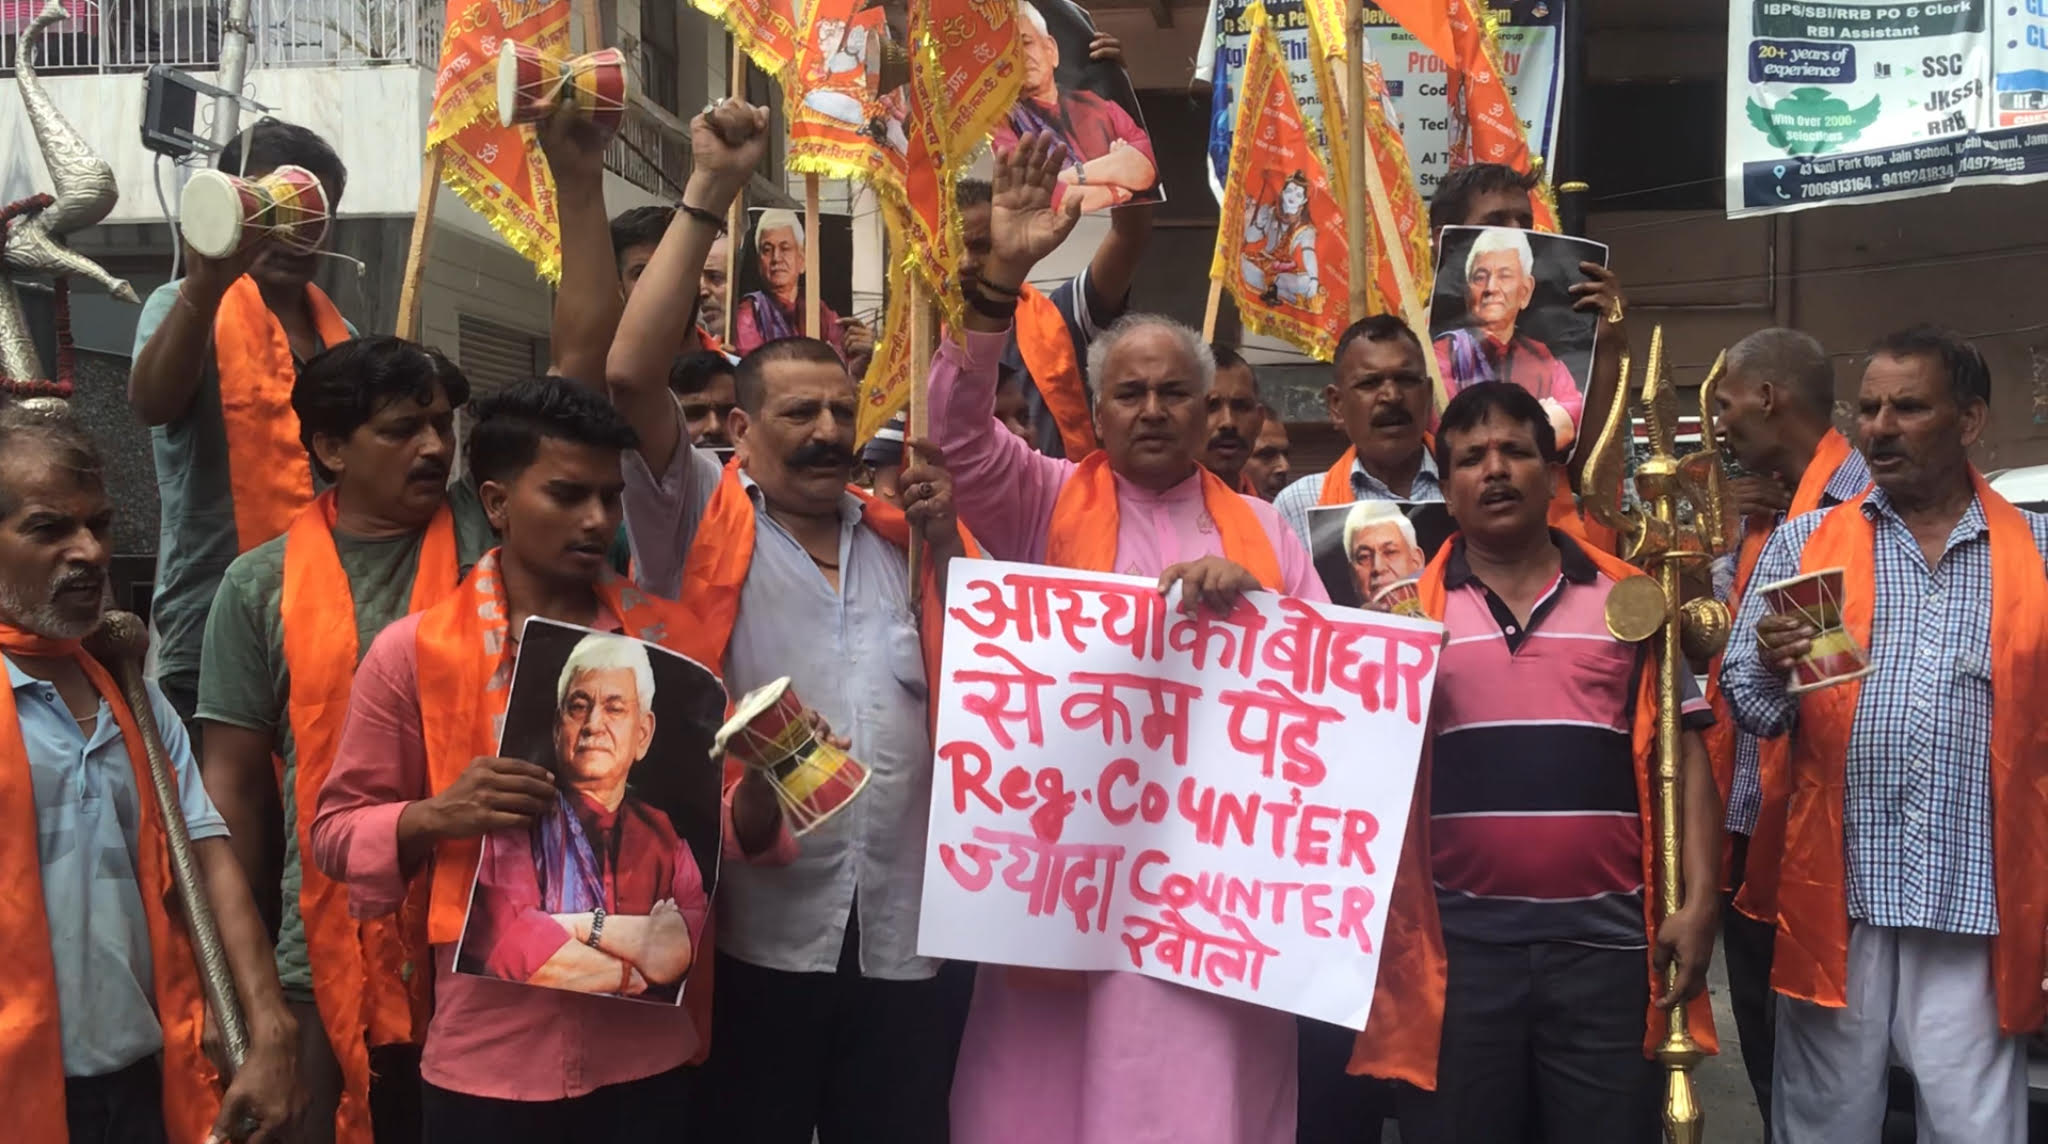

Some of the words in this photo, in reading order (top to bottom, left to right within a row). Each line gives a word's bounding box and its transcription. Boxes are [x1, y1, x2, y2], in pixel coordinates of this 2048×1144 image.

[1763, 3, 1871, 20] IBPS/SBI/RRB
[1876, 8, 1901, 20] PO
[1906, 6, 1920, 18] &
[1925, 1, 1971, 16] Clerk
[1806, 25, 1835, 37] RBI
[1840, 25, 1920, 39] Assistant
[1758, 45, 1788, 59] 20+
[1789, 47, 1830, 63] years
[1832, 47, 1850, 64] of
[1763, 62, 1841, 77] experience
[1922, 53, 1963, 78] SSC
[1771, 113, 1795, 126] With
[1797, 114, 1821, 127] Over
[1927, 110, 1967, 136] RRB
[1800, 163, 1812, 176] 43
[1838, 158, 1862, 171] Park
[1889, 149, 1912, 164] Jain
[1800, 176, 1872, 198] 7006913164
[952, 643, 1057, 750] से
[1060, 671, 1204, 766] कम
